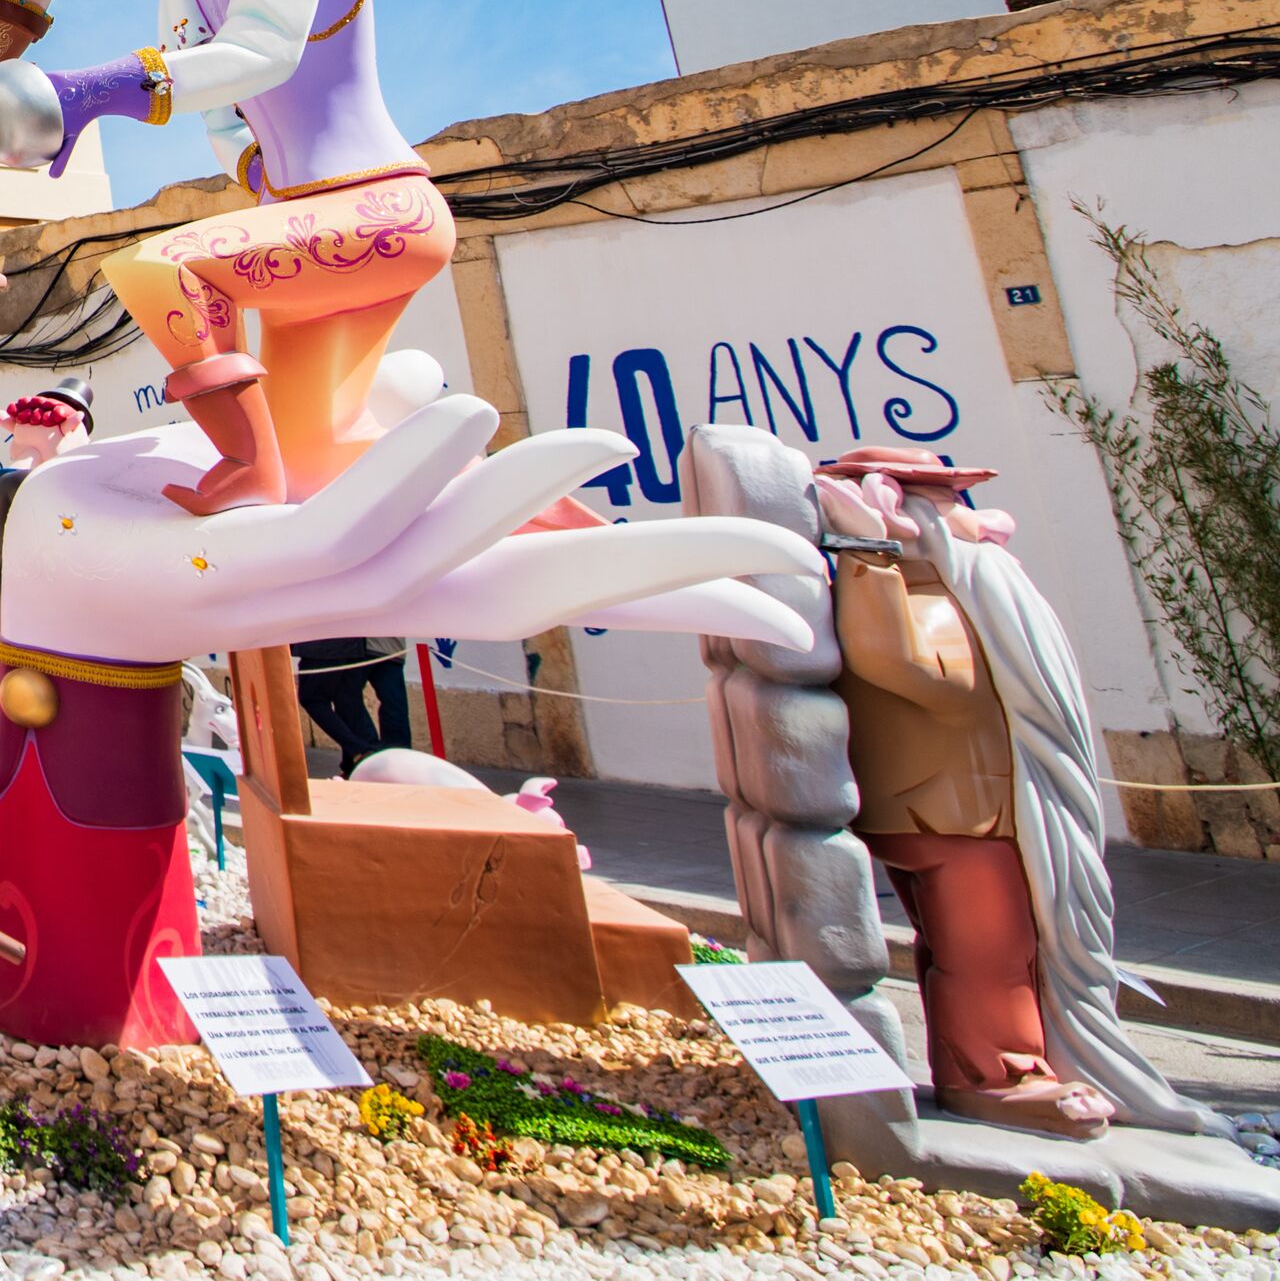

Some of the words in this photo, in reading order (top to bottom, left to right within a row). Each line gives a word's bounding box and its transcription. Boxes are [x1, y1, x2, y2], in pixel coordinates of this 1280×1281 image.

[1012, 288, 1034, 303] 21
[707, 325, 959, 442] ANYS
[184, 991, 199, 999] LOS
[200, 991, 240, 999] CIUDADANOS
[201, 1011, 237, 1019] TREBALLEN
[207, 1031, 224, 1039] UNA
[262, 1028, 299, 1036] PRESENTEN
